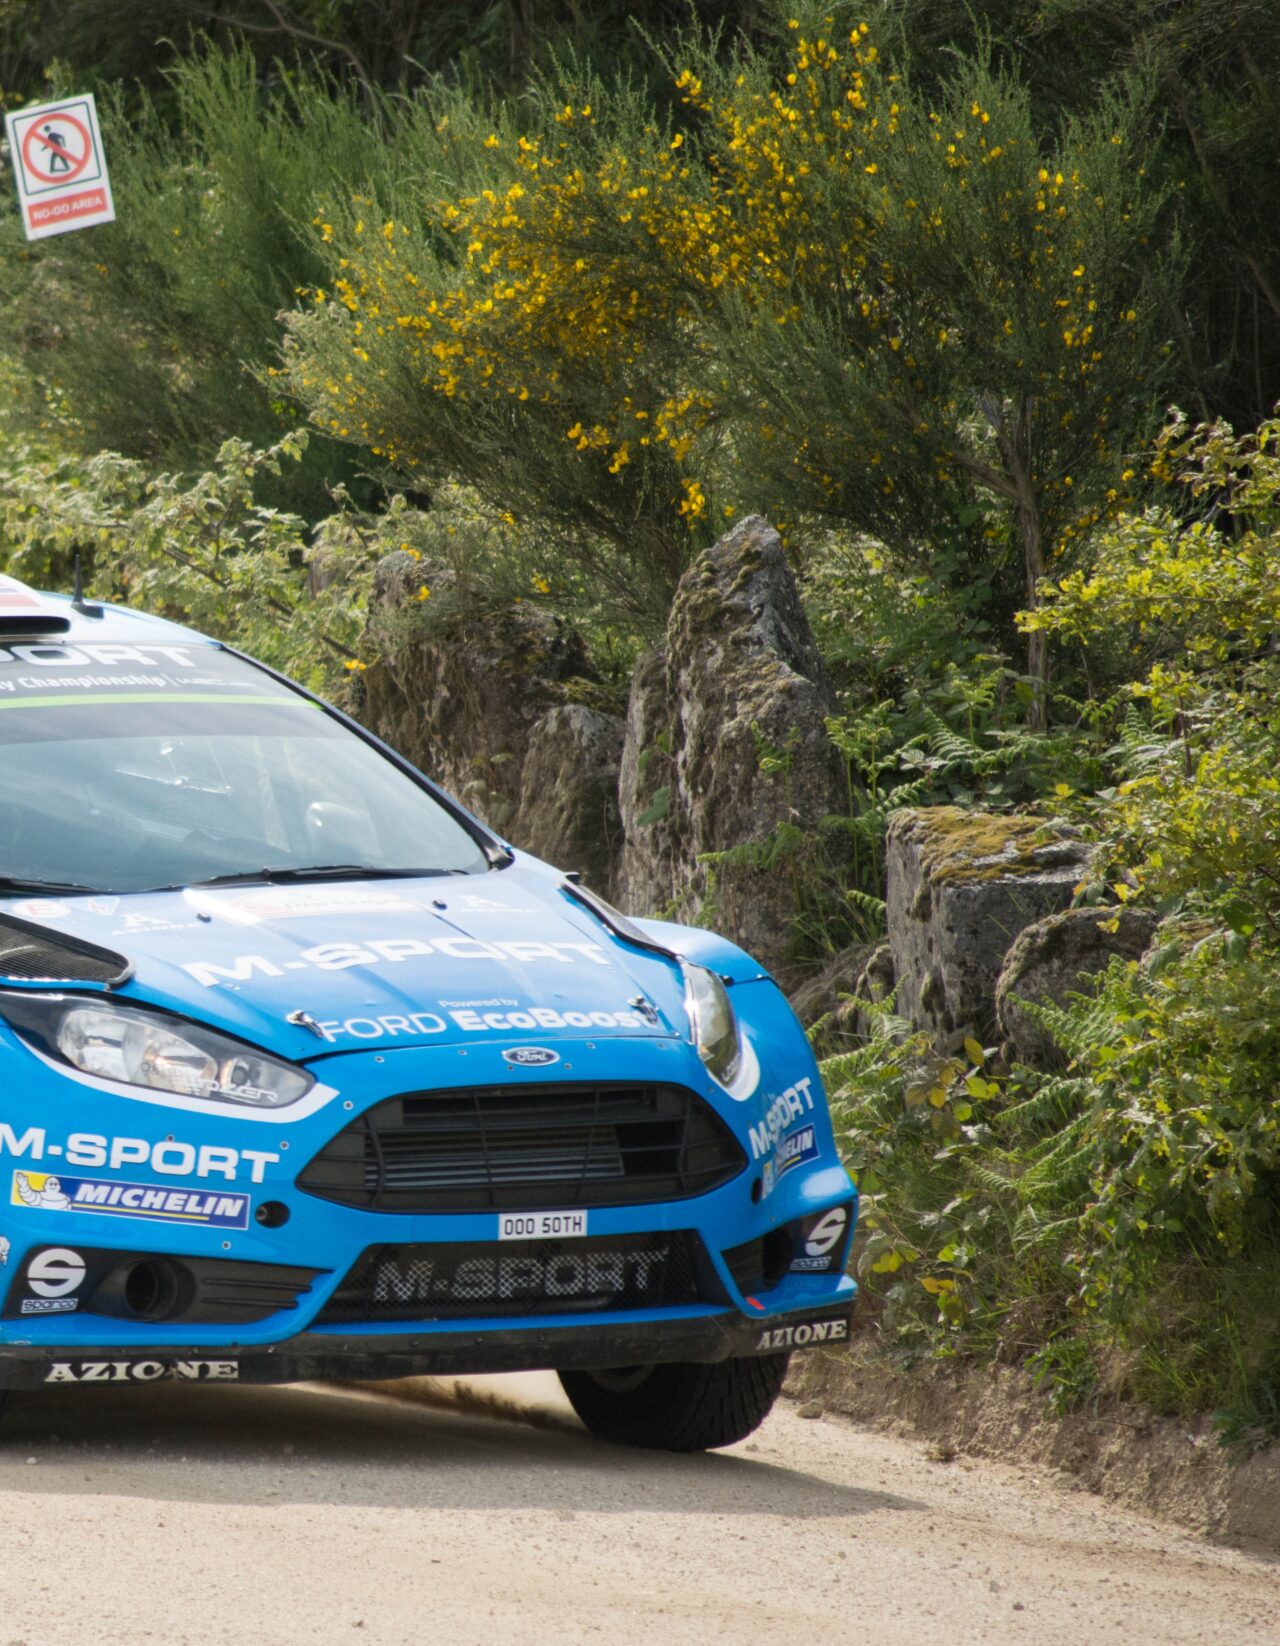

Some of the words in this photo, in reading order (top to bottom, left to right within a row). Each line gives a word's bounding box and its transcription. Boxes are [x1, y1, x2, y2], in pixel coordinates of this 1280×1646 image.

[34, 205, 69, 220] NO-GO
[73, 197, 102, 211] AREA
[19, 674, 166, 691] Championship
[190, 937, 611, 988] M-SPORT
[438, 999, 500, 1008] Powered
[503, 998, 519, 1007] by
[320, 1014, 447, 1042] FORD
[74, 1182, 244, 1218] MICHELIN
[373, 1245, 670, 1302] M-SPORT
[23, 1299, 78, 1312] sparco
[755, 1319, 848, 1350] AZIONE
[44, 1360, 240, 1383] AZIONE
